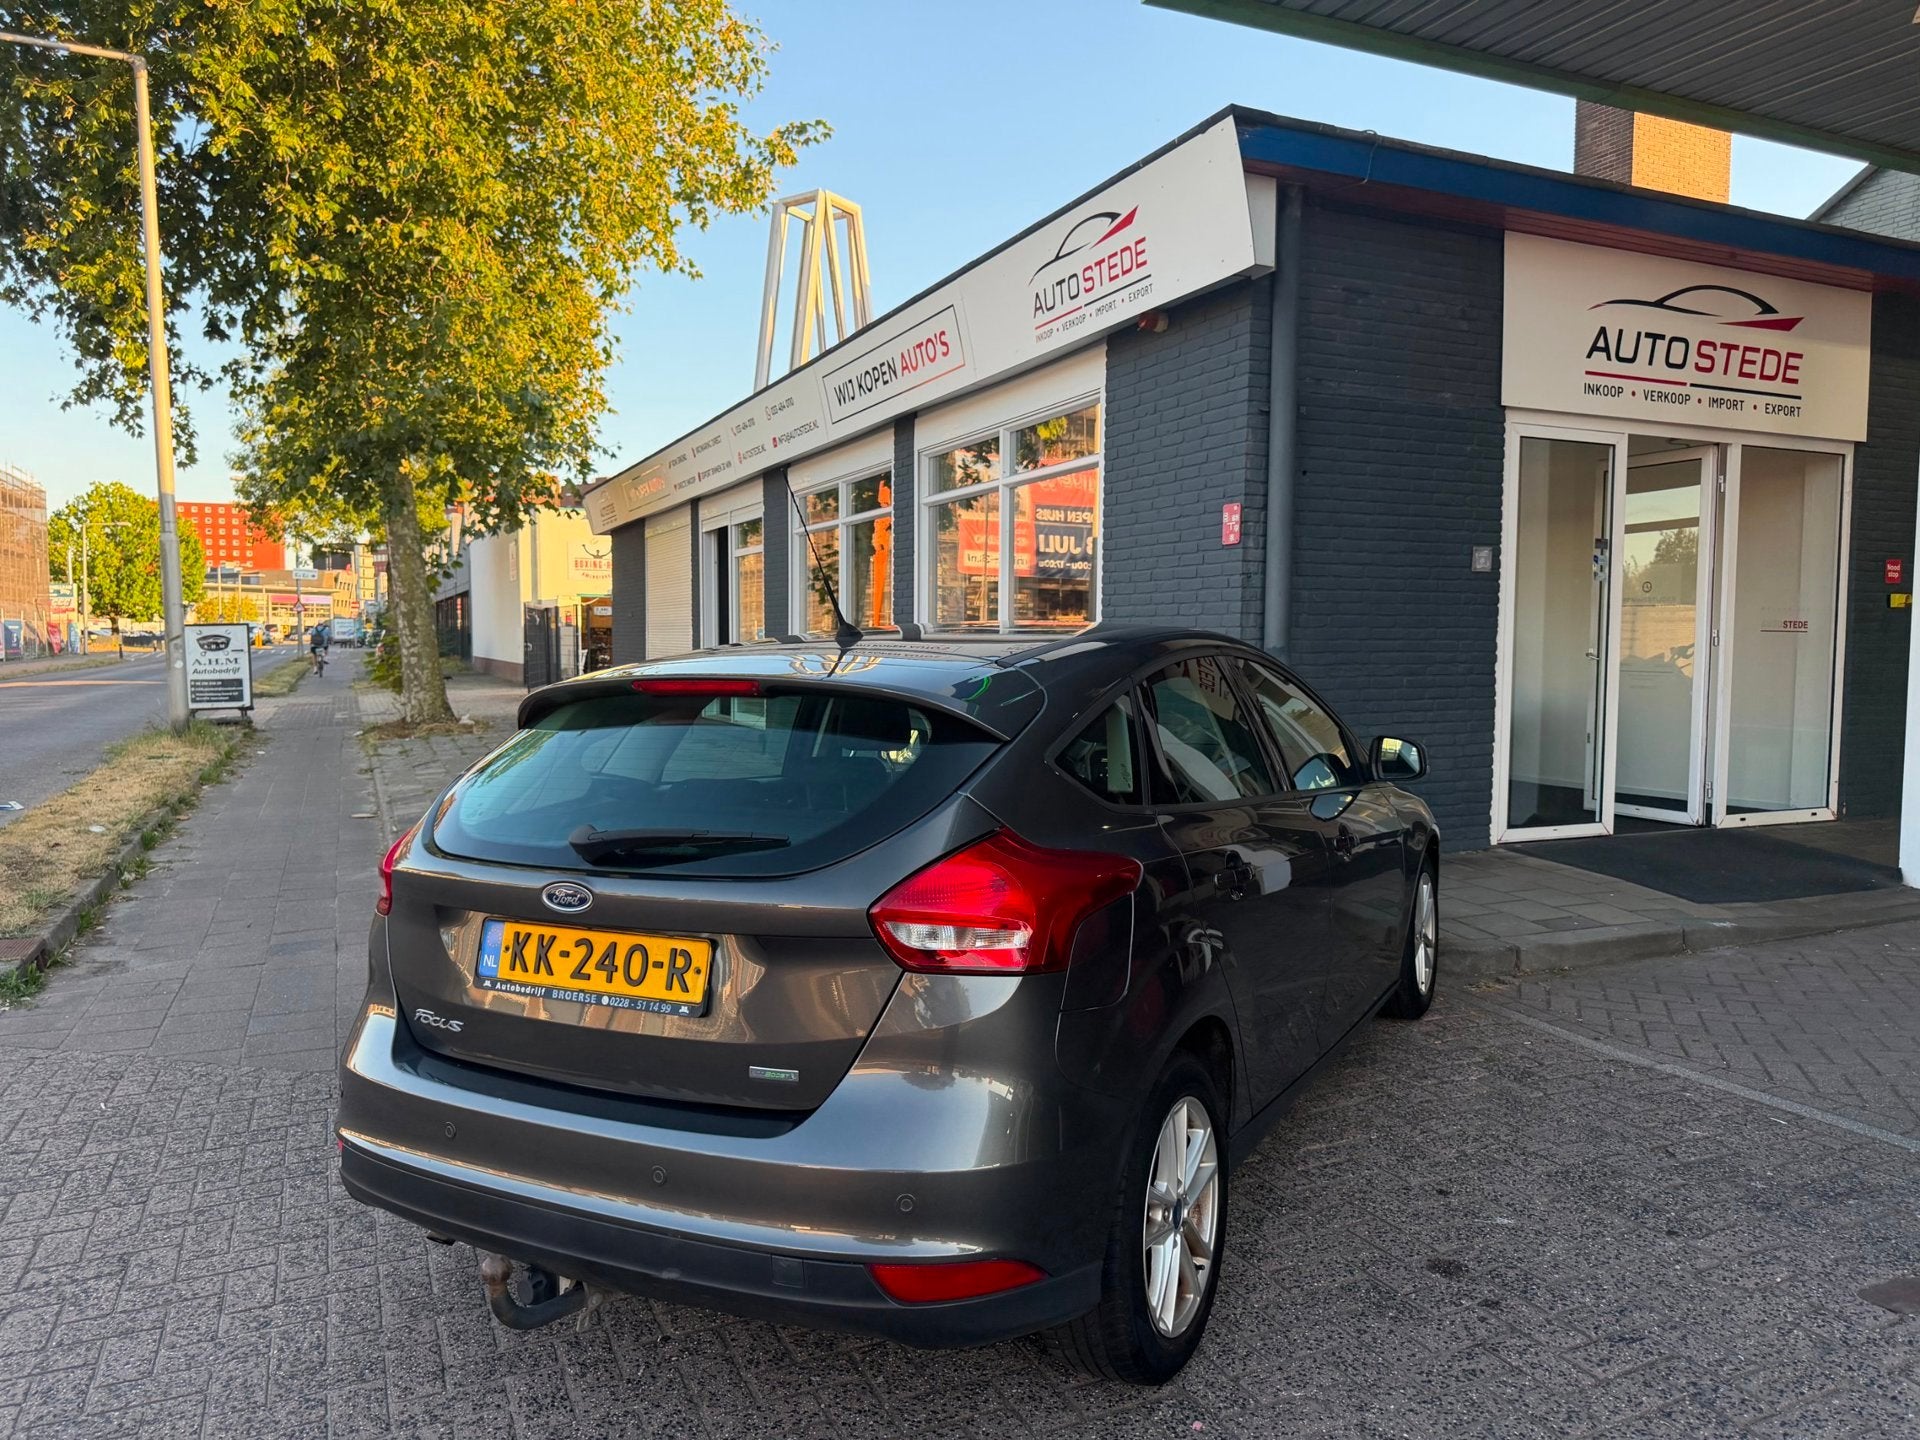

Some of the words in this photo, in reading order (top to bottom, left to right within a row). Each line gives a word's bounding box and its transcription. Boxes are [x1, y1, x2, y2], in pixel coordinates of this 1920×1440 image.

[1033, 236, 1148, 319] AUTOSTEDE
[1061, 313, 1087, 332] VERKOOP
[1095, 299, 1118, 317] IMPORT
[1128, 283, 1154, 303] EXPORT
[834, 379, 856, 407] WIJ
[856, 356, 898, 397] KOPEN
[900, 330, 950, 377] AUTO'S
[1585, 325, 1805, 386] AUTOSTEDE
[1583, 382, 1625, 399] INKOOP
[1643, 388, 1692, 406] VERKOOP
[1708, 396, 1745, 412] IMPORT
[1764, 403, 1803, 419] EXPORT
[192, 667, 240, 675] Autobedrijf
[552, 888, 582, 906] Ford
[483, 954, 498, 968] NL
[508, 930, 691, 994] KK-240-R
[495, 981, 546, 997] Autobedrijf
[552, 989, 598, 1004] BROERSE
[609, 996, 630, 1009] 0228
[636, 1000, 647, 1010] 51
[648, 1001, 660, 1012] 14
[660, 1003, 672, 1014] 99
